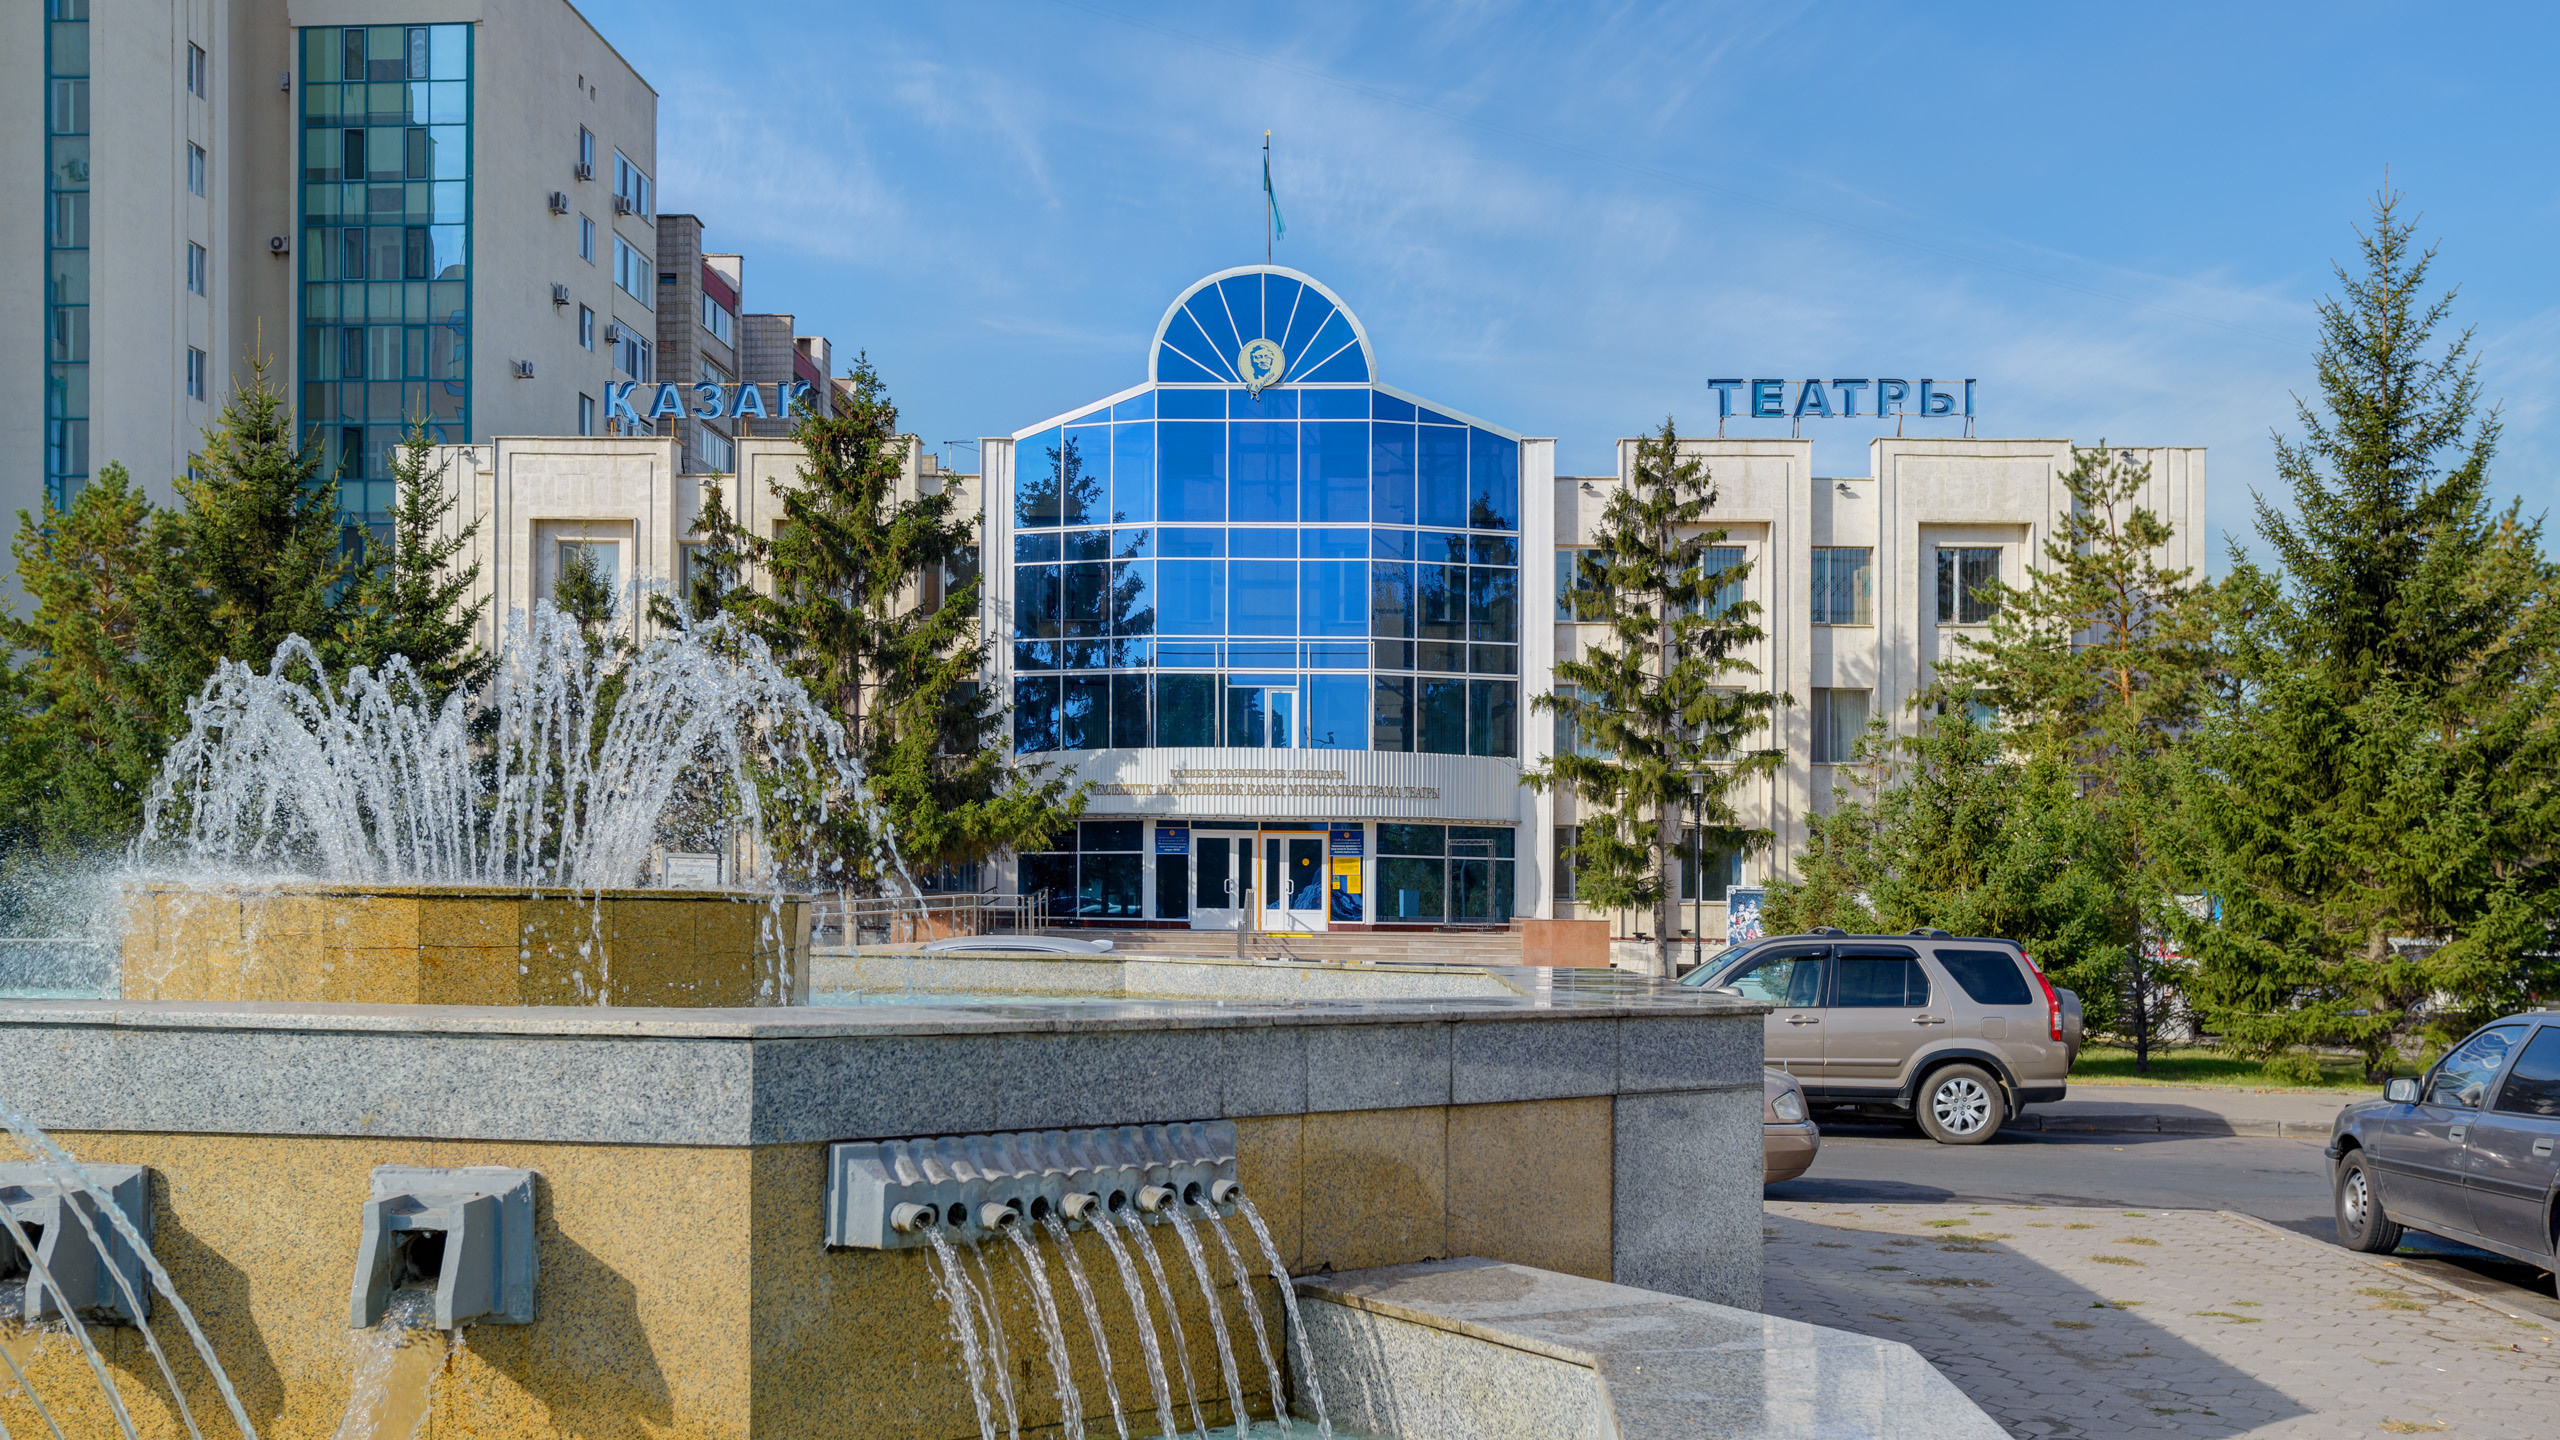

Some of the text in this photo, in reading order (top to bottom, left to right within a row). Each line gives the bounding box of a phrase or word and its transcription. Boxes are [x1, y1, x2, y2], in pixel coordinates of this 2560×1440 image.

[1707, 379, 1977, 418] ТЕАТРЫ
[1365, 785, 1401, 798] ДРАМА
[1403, 786, 1440, 799] ТЕАТРЫ
